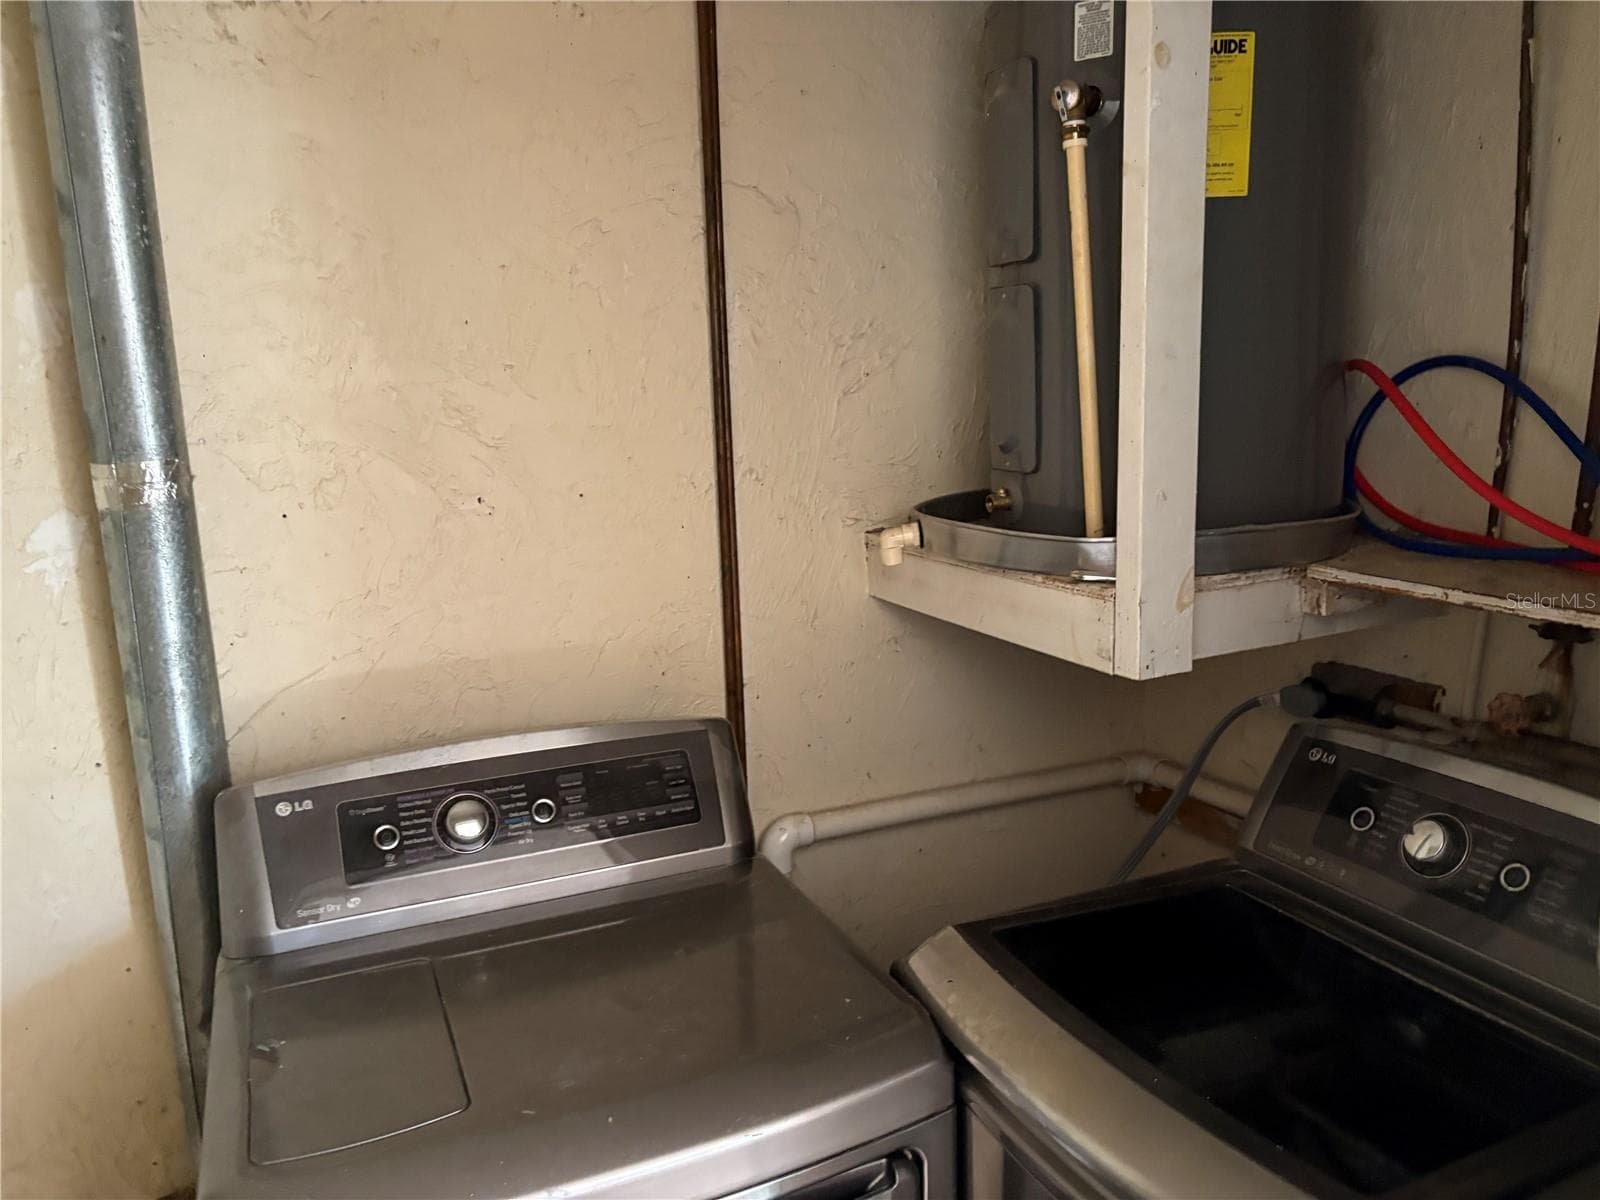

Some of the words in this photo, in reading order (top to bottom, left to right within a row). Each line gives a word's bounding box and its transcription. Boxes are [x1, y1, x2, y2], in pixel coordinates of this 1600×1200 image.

[1321, 751, 1337, 765] LG
[294, 800, 313, 812] LG
[296, 906, 326, 918] Sensor
[326, 904, 341, 914] Dry
